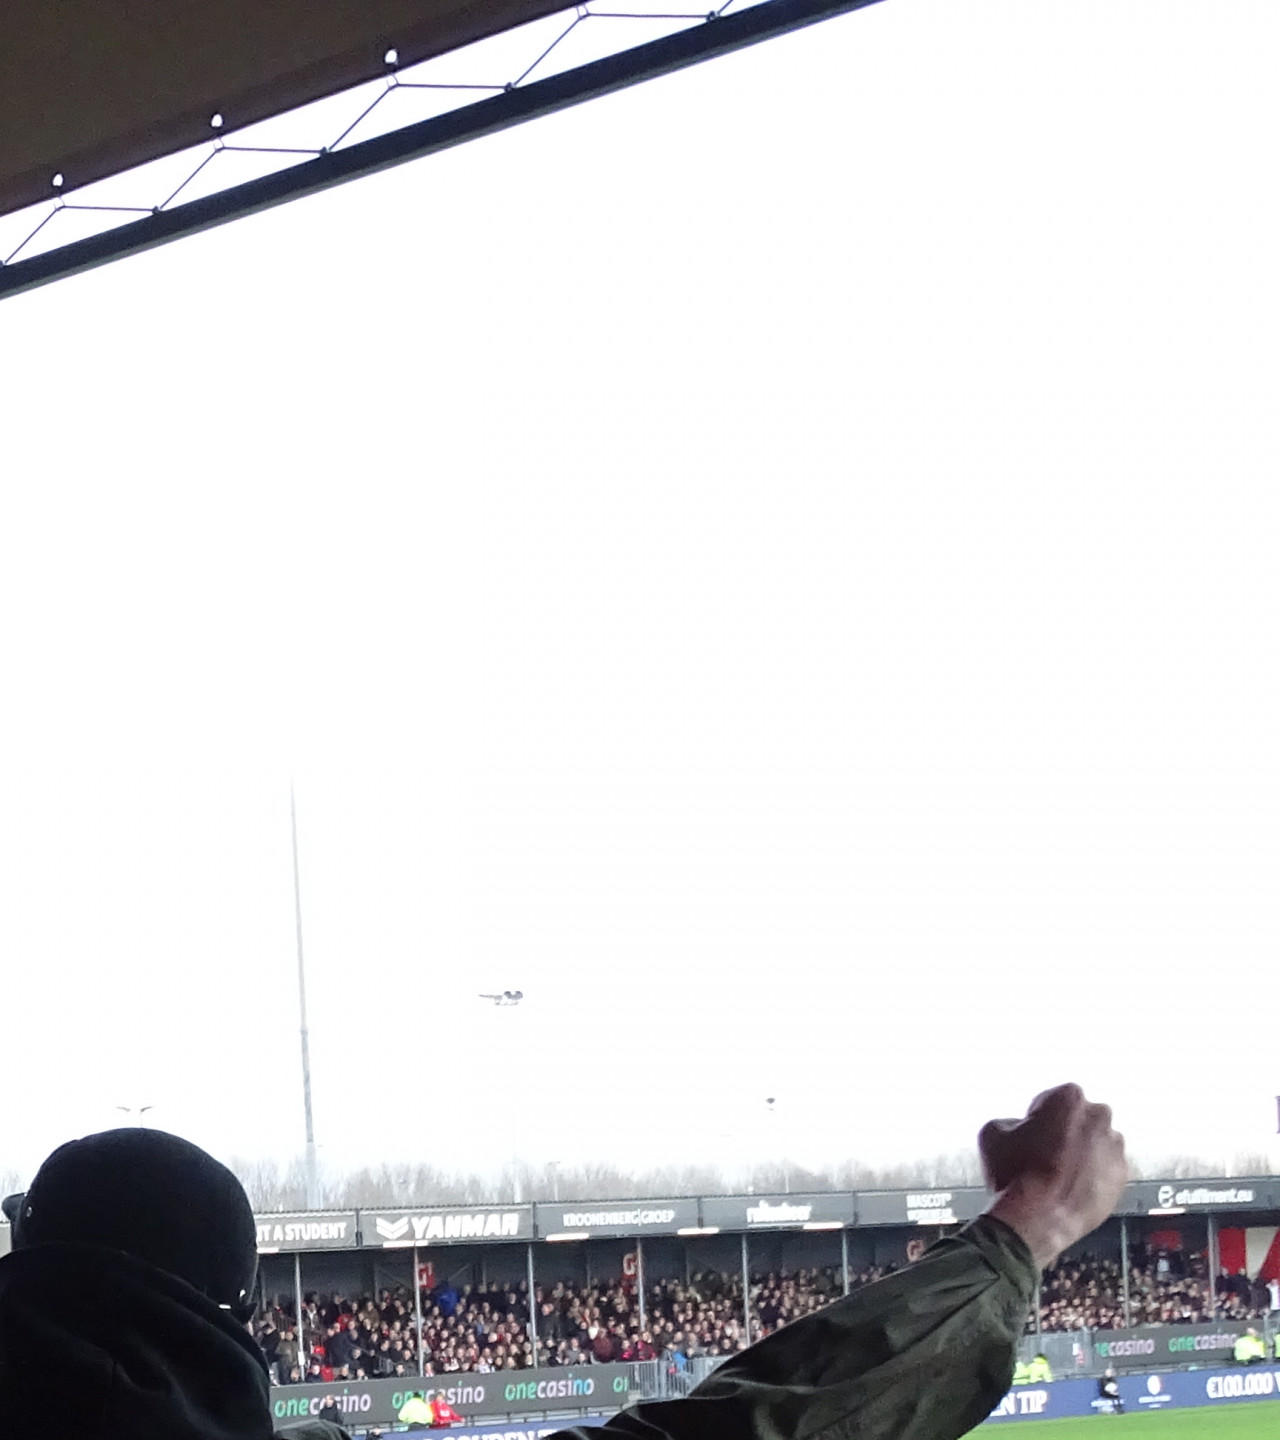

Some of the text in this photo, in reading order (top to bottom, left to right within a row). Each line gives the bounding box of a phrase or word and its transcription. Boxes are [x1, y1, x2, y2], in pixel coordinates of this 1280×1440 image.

[285, 1222, 347, 1241] STUDENT
[411, 1213, 519, 1240] YANMAR
[505, 1373, 594, 1401] onecasino
[1016, 1390, 1047, 1414] TIP
